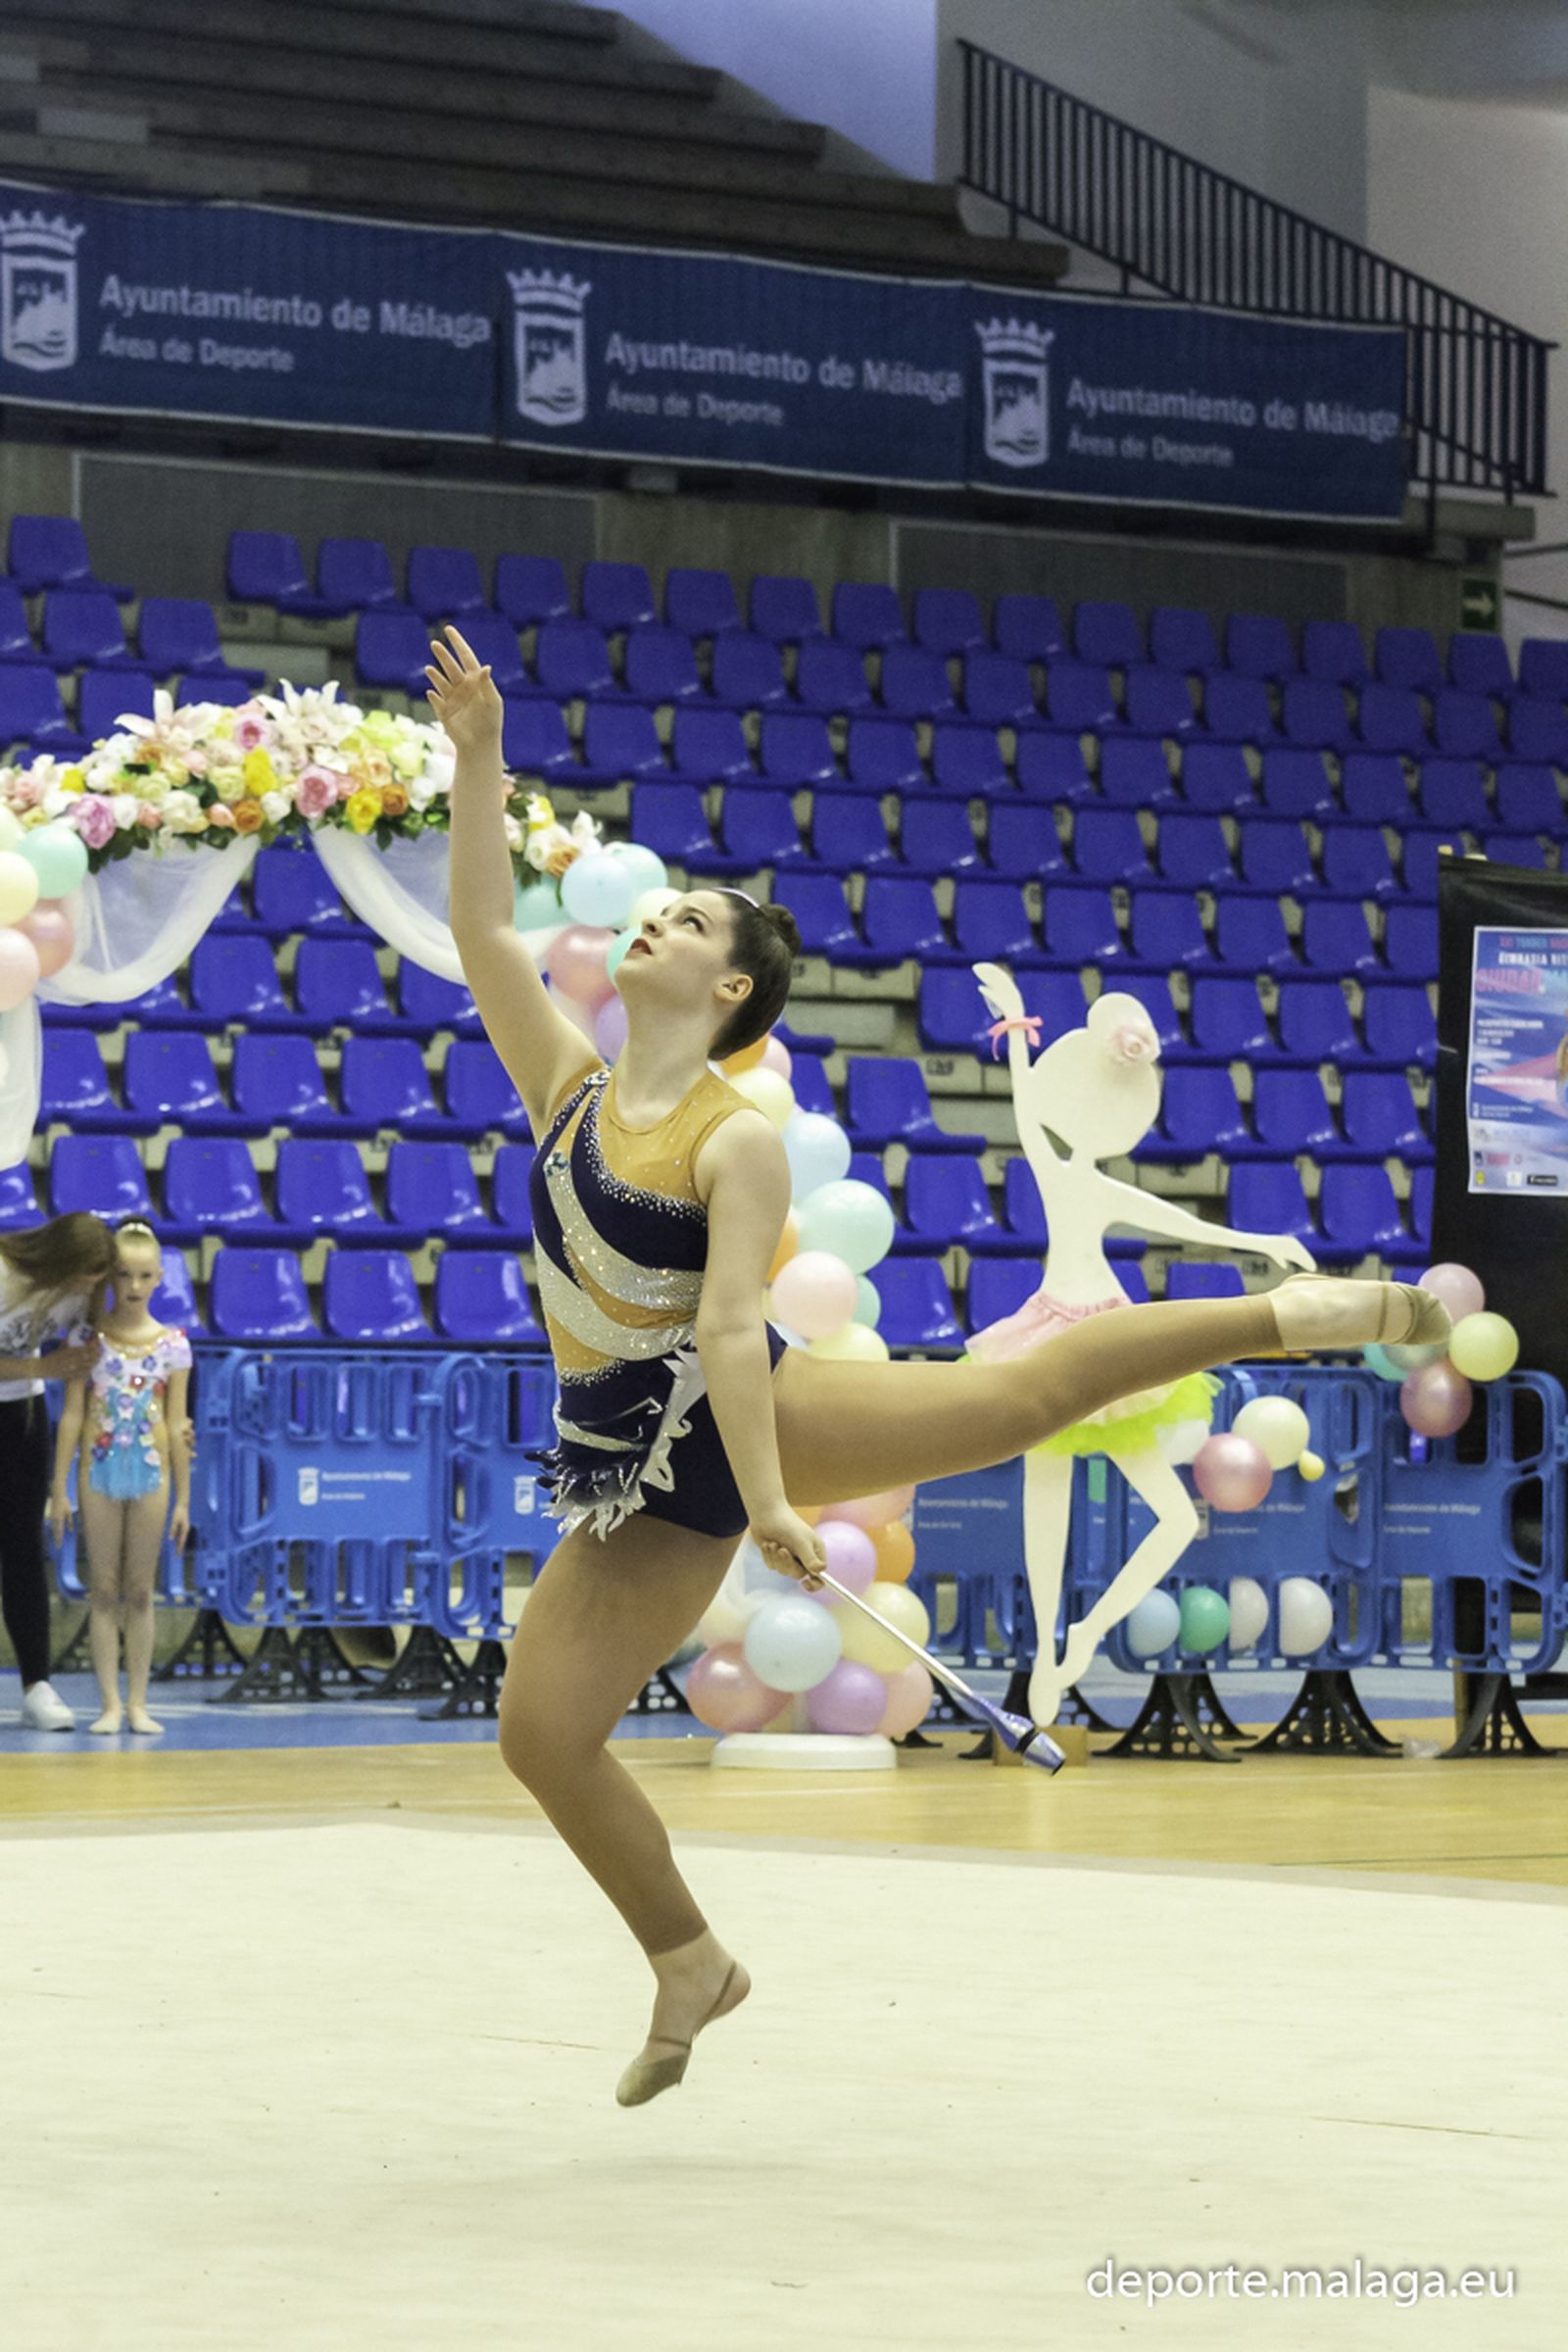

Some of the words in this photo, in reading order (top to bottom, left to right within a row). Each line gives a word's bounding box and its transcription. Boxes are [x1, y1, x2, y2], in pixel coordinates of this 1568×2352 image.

[100, 273, 321, 328] Ayuntamiento
[331, 299, 370, 332] de
[379, 301, 490, 349] Málaga
[99, 323, 156, 361] Área
[162, 335, 193, 363] de
[199, 337, 294, 371] Deporte
[605, 331, 810, 384] Ayuntamiento
[818, 356, 856, 389] de
[862, 359, 963, 405] Málaga
[663, 391, 691, 416] de
[697, 393, 784, 426] Deporte
[1066, 377, 1256, 428] Ayuntamiento
[1263, 398, 1298, 430] de
[1303, 400, 1400, 444] Málaga
[1120, 432, 1147, 458] de
